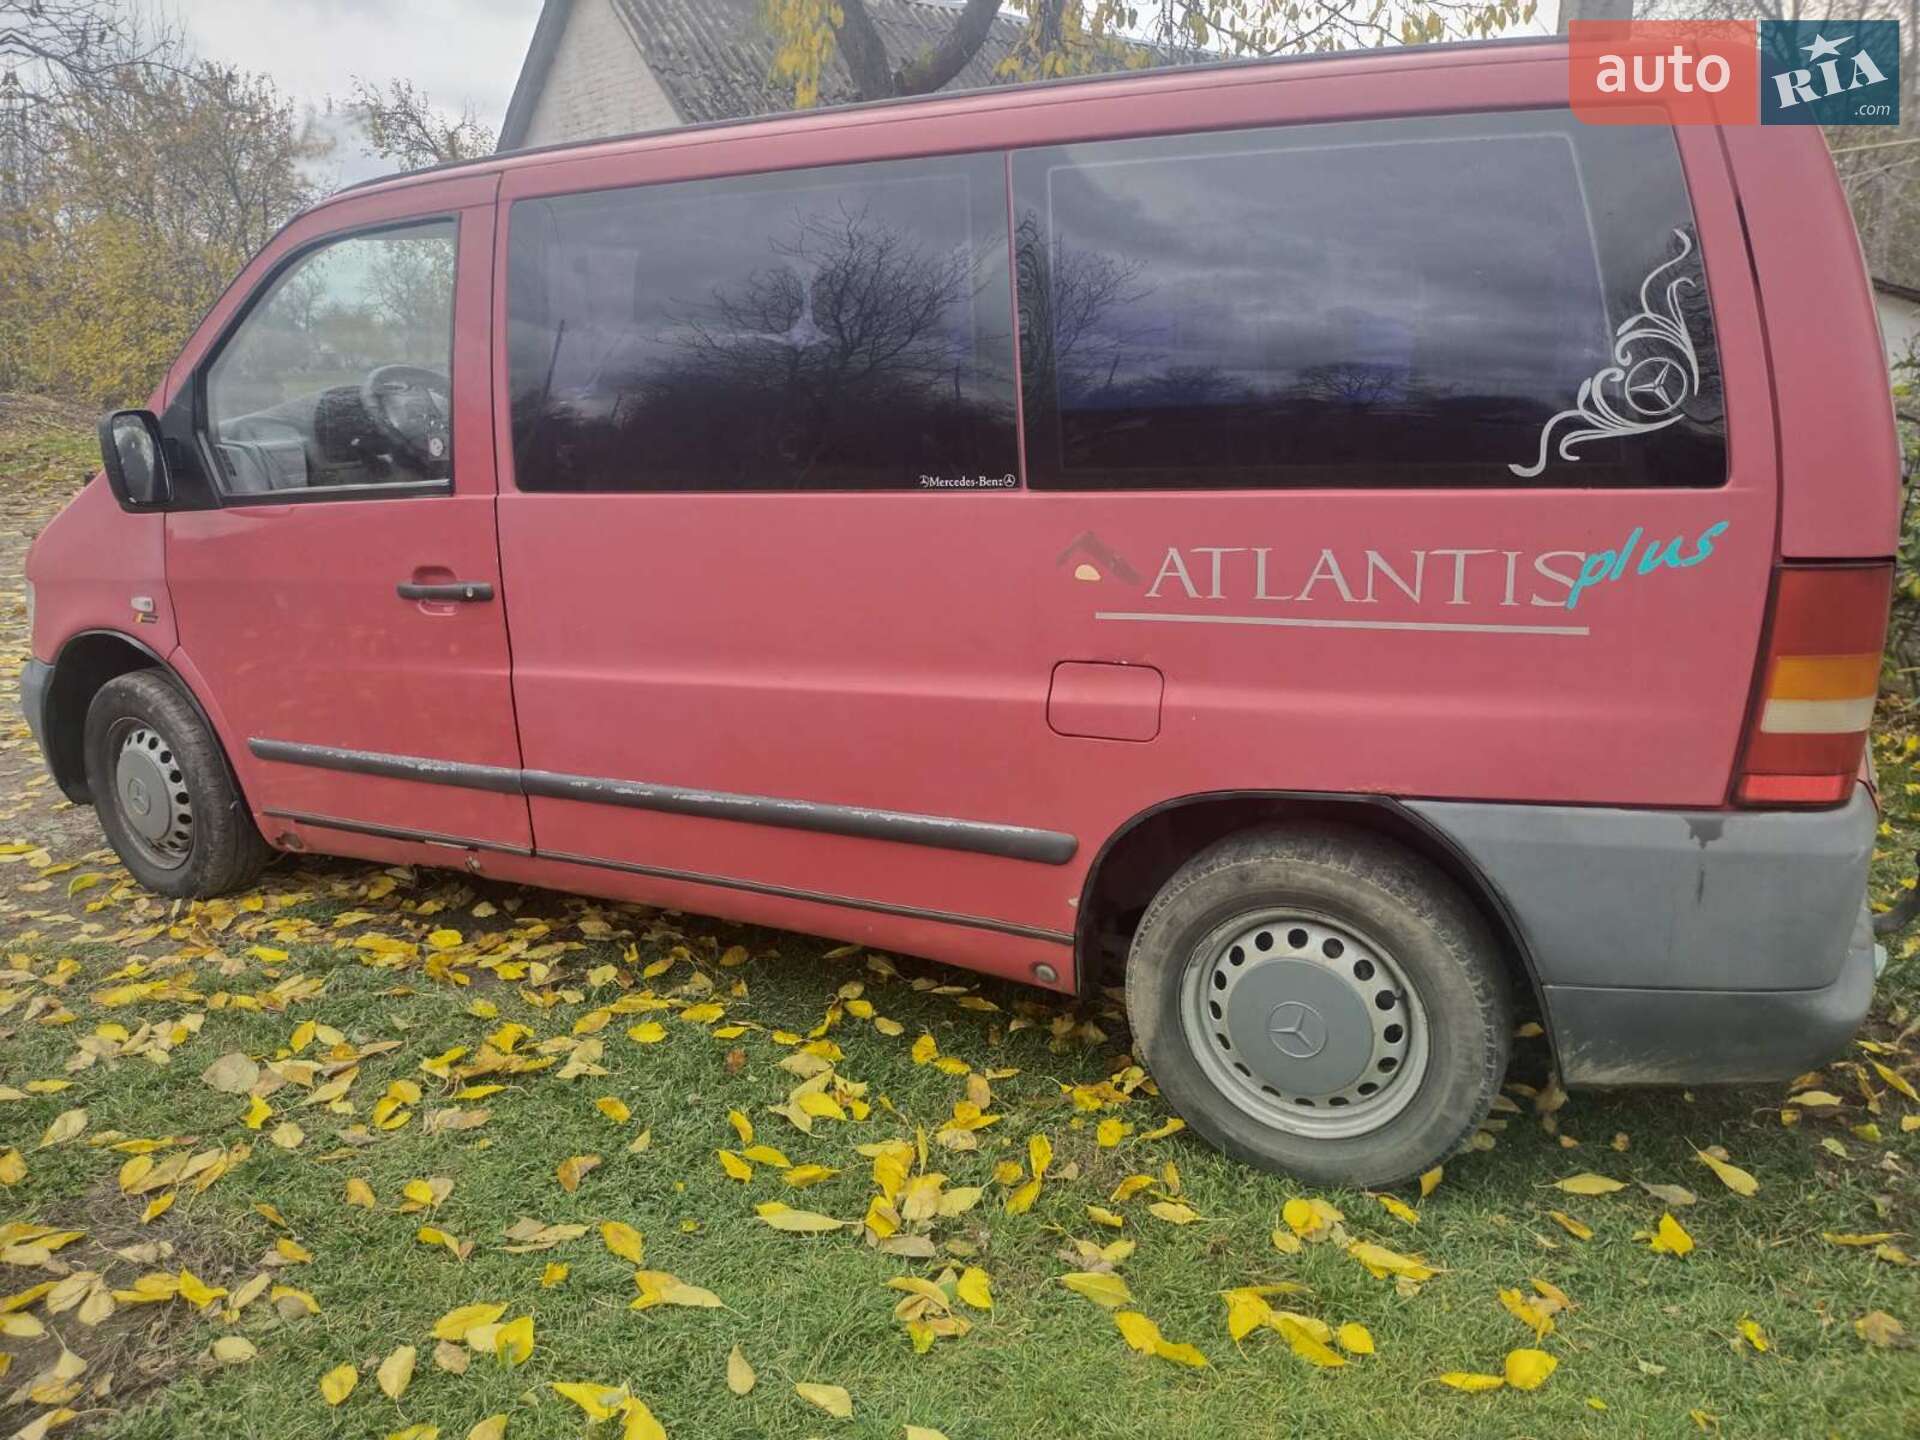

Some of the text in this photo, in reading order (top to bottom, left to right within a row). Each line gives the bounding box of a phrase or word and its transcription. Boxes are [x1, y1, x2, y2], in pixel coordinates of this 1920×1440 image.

[929, 475, 1003, 488] Mercedes-Benz
[1144, 519, 1729, 610] ATLANTIS plus
